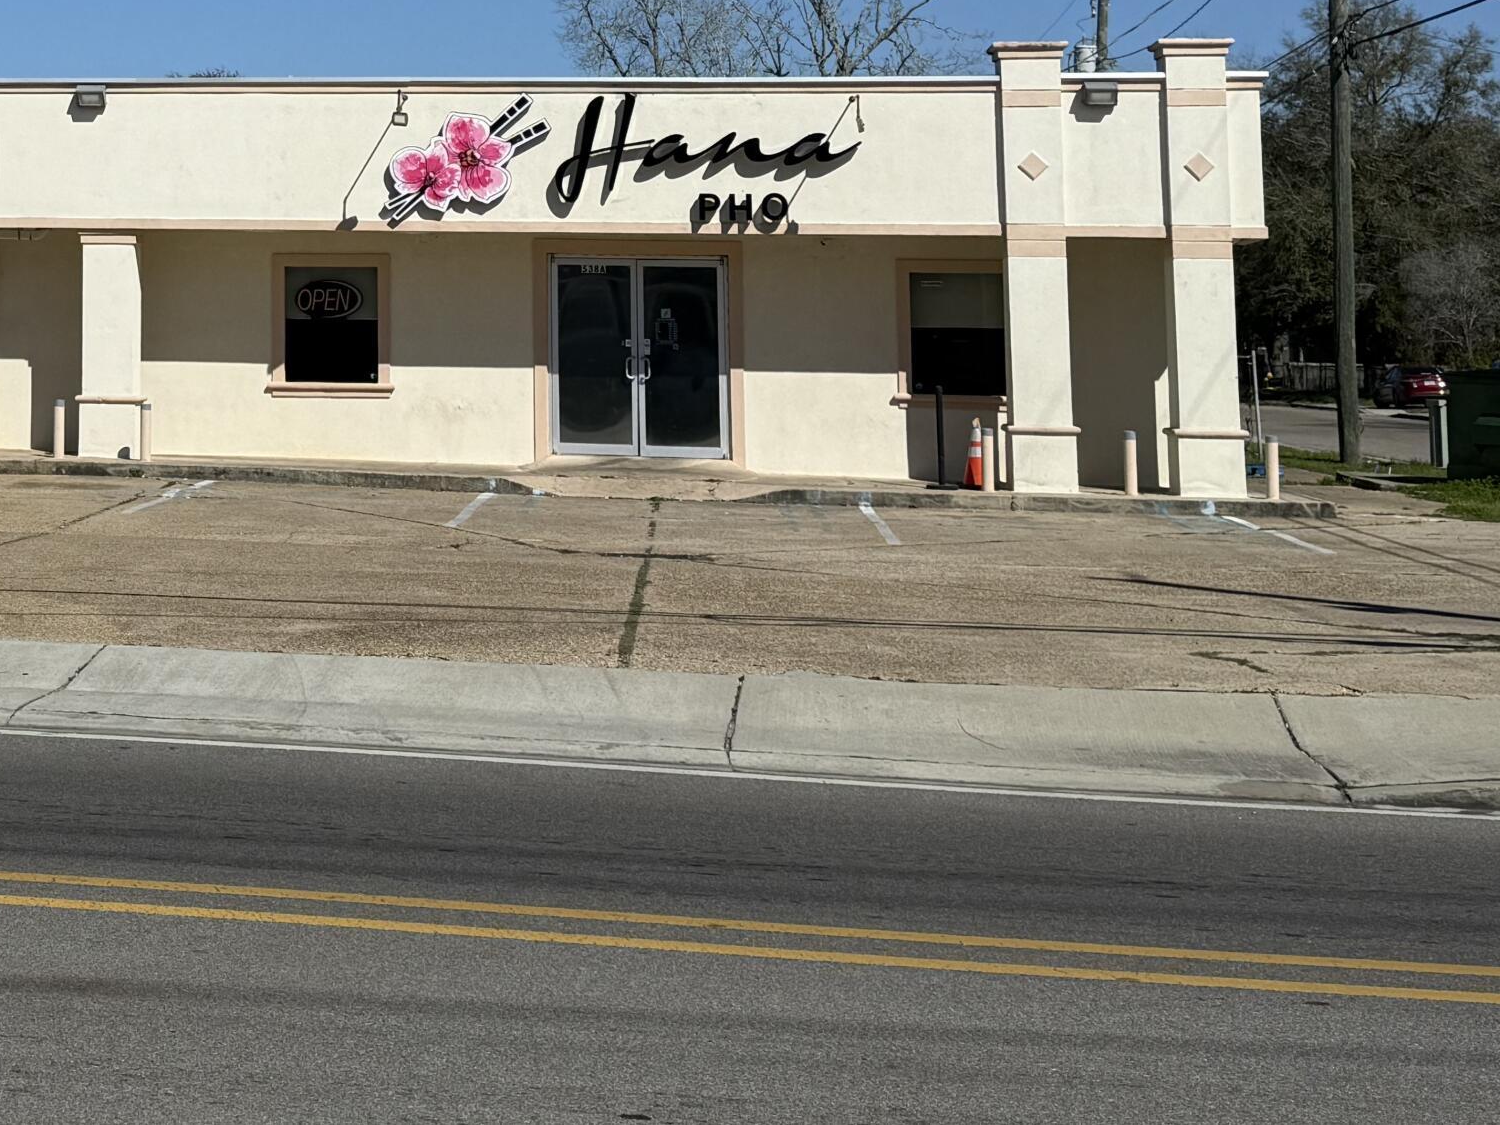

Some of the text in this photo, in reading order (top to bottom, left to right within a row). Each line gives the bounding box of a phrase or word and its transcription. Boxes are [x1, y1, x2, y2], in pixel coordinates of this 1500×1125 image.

[554, 93, 862, 203] Hana
[699, 193, 788, 221] PHO
[297, 288, 350, 311] OPEN
